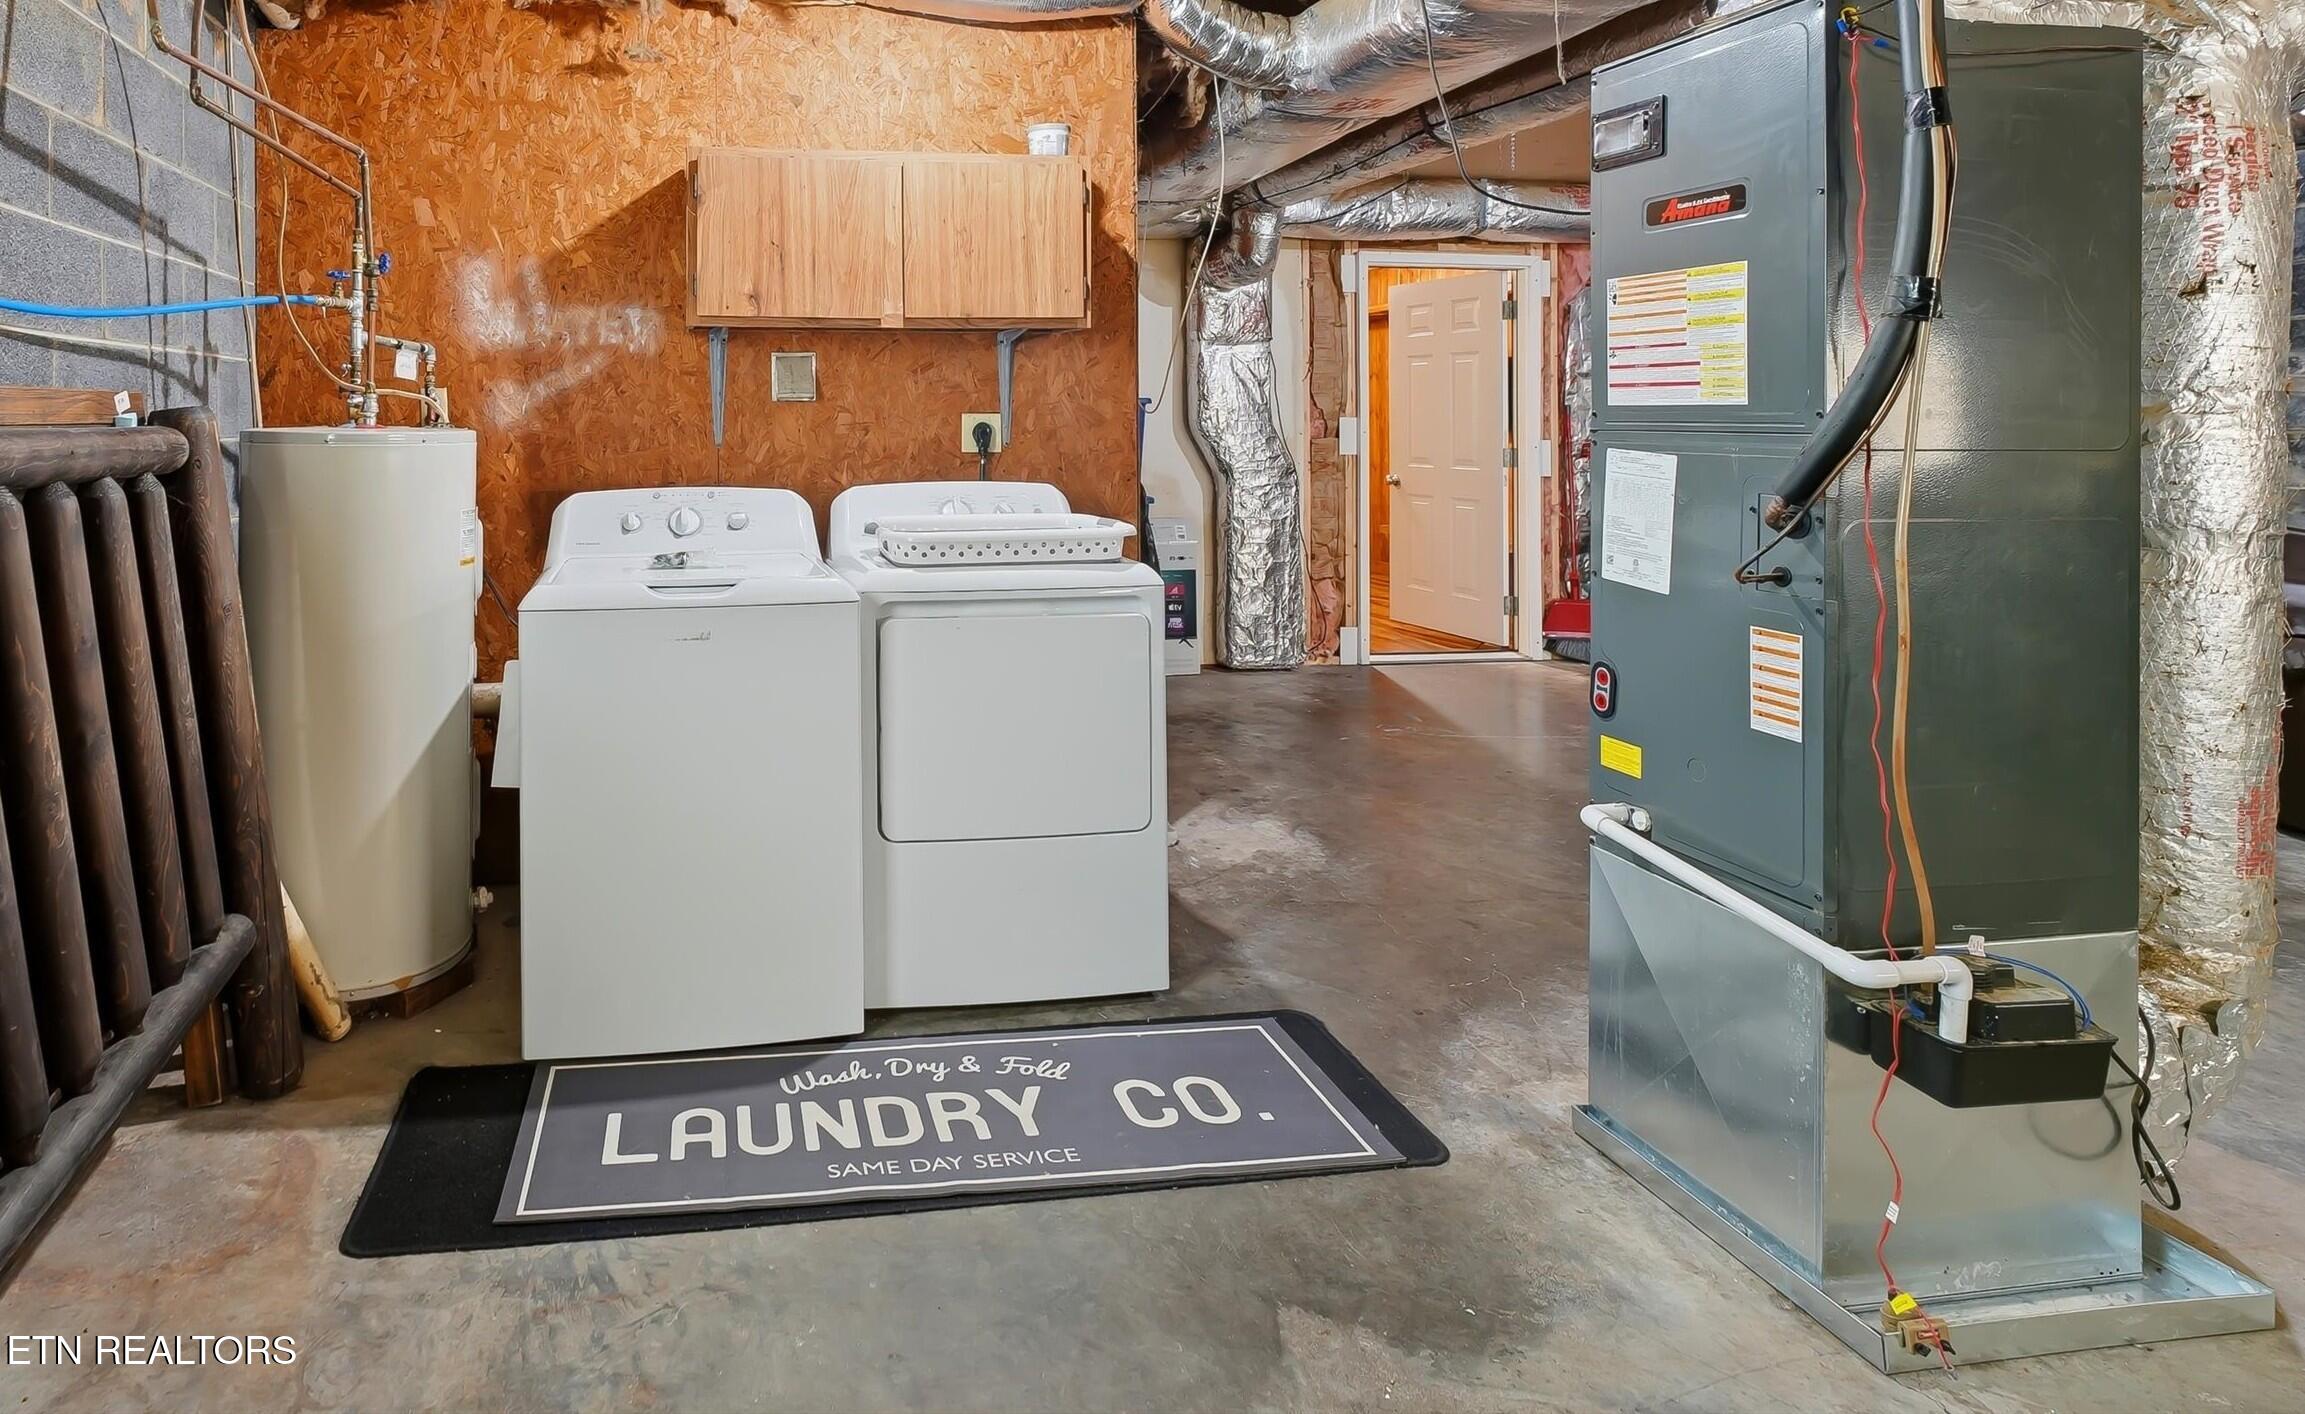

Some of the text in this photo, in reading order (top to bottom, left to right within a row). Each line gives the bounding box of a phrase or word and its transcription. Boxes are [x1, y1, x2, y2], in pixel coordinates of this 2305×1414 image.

[2202, 167, 2225, 216] Duct
[1661, 196, 1731, 223] Amana
[884, 1057, 951, 1082] Dry
[957, 1055, 981, 1074] &
[995, 1055, 1071, 1081] Fold
[601, 1075, 1275, 1166] LAUNDRY CO.
[826, 1147, 1082, 1179] SAME DAY SERVICE
